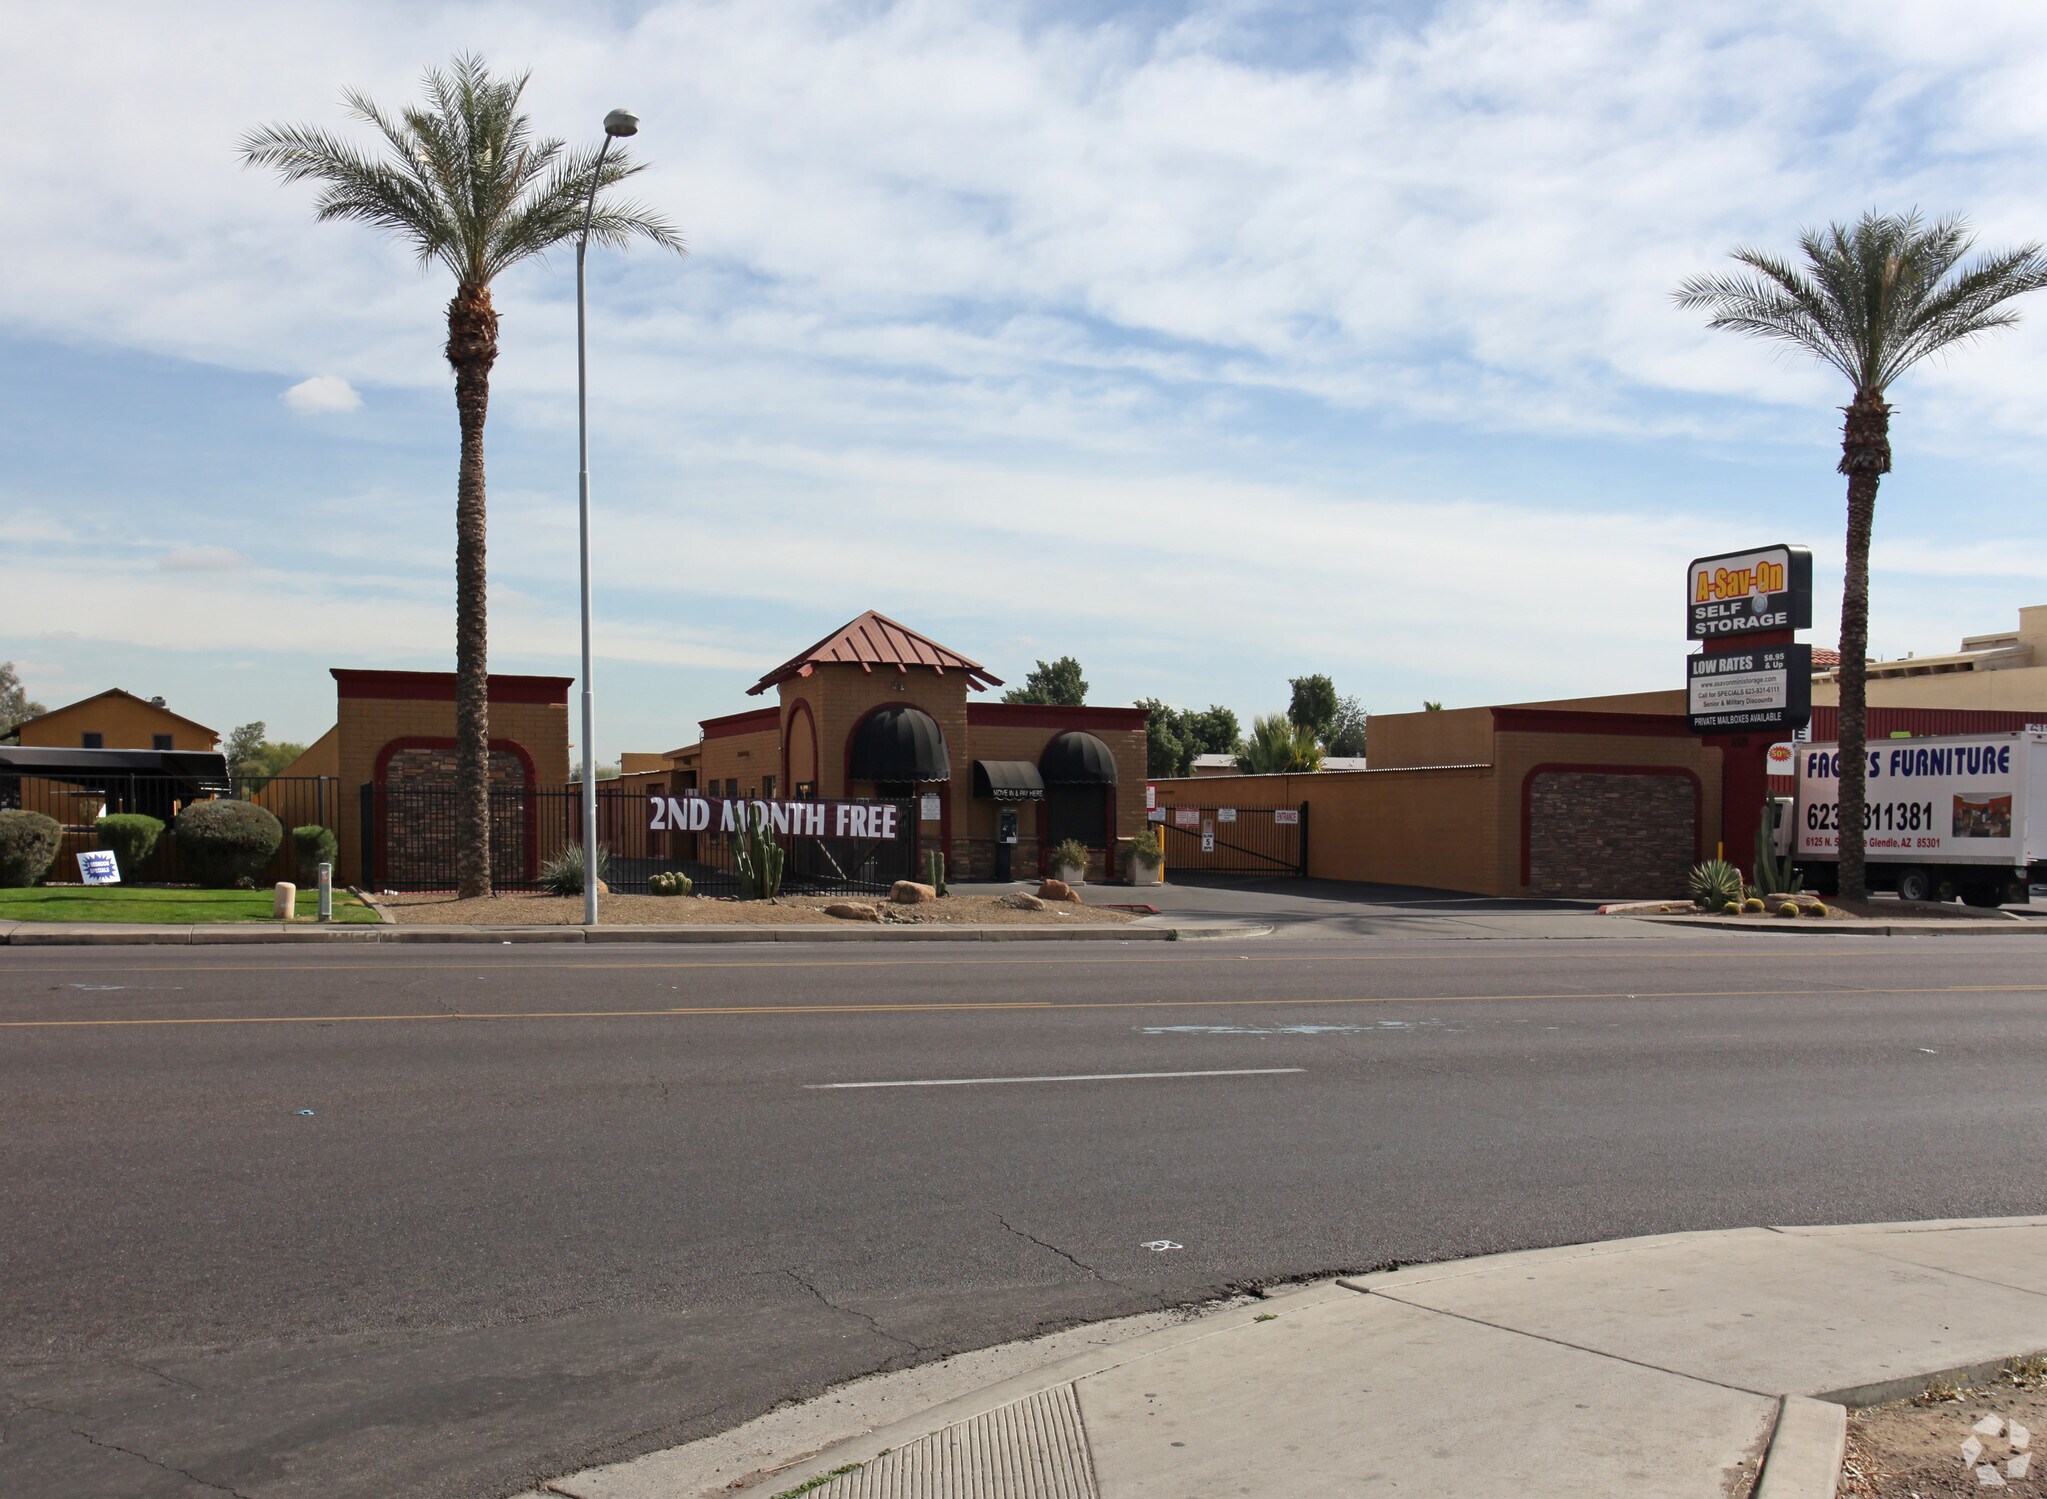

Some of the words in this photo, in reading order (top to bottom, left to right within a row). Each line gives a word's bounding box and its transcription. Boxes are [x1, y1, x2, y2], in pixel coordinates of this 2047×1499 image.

[1695, 561, 1783, 602] A-Sav-On
[1695, 602, 1742, 619] SELF
[1695, 612, 1788, 635] STORAGE
[1764, 653, 1784, 662] $8.95
[1693, 660, 1717, 675] LOW
[1719, 656, 1753, 672] RATES
[1773, 661, 1783, 669] Up
[1717, 689, 1744, 698] SPECIALS
[1703, 700, 1719, 708] Senior
[1726, 698, 1745, 707] Military
[1746, 696, 1773, 705] Discounts
[1694, 717, 1716, 726] PRIVATE
[1717, 714, 1749, 725] MAILBOXES
[1750, 712, 1782, 722] AVAILABLE
[1890, 745, 2010, 777] FURNITURE
[993, 789, 1008, 797] MOVE
[1009, 789, 1015, 797] IN
[1030, 789, 1043, 797] HERE
[650, 797, 710, 831] 2ND
[720, 799, 825, 836] MONTH
[836, 804, 896, 839] FREE
[1276, 812, 1297, 822] ENTRANCE
[1806, 837, 1823, 847] 6125
[1825, 837, 1832, 847] N.
[1869, 837, 1900, 849] Glendle,
[1901, 837, 1912, 848] AZ
[1917, 838, 1940, 848] 85301
